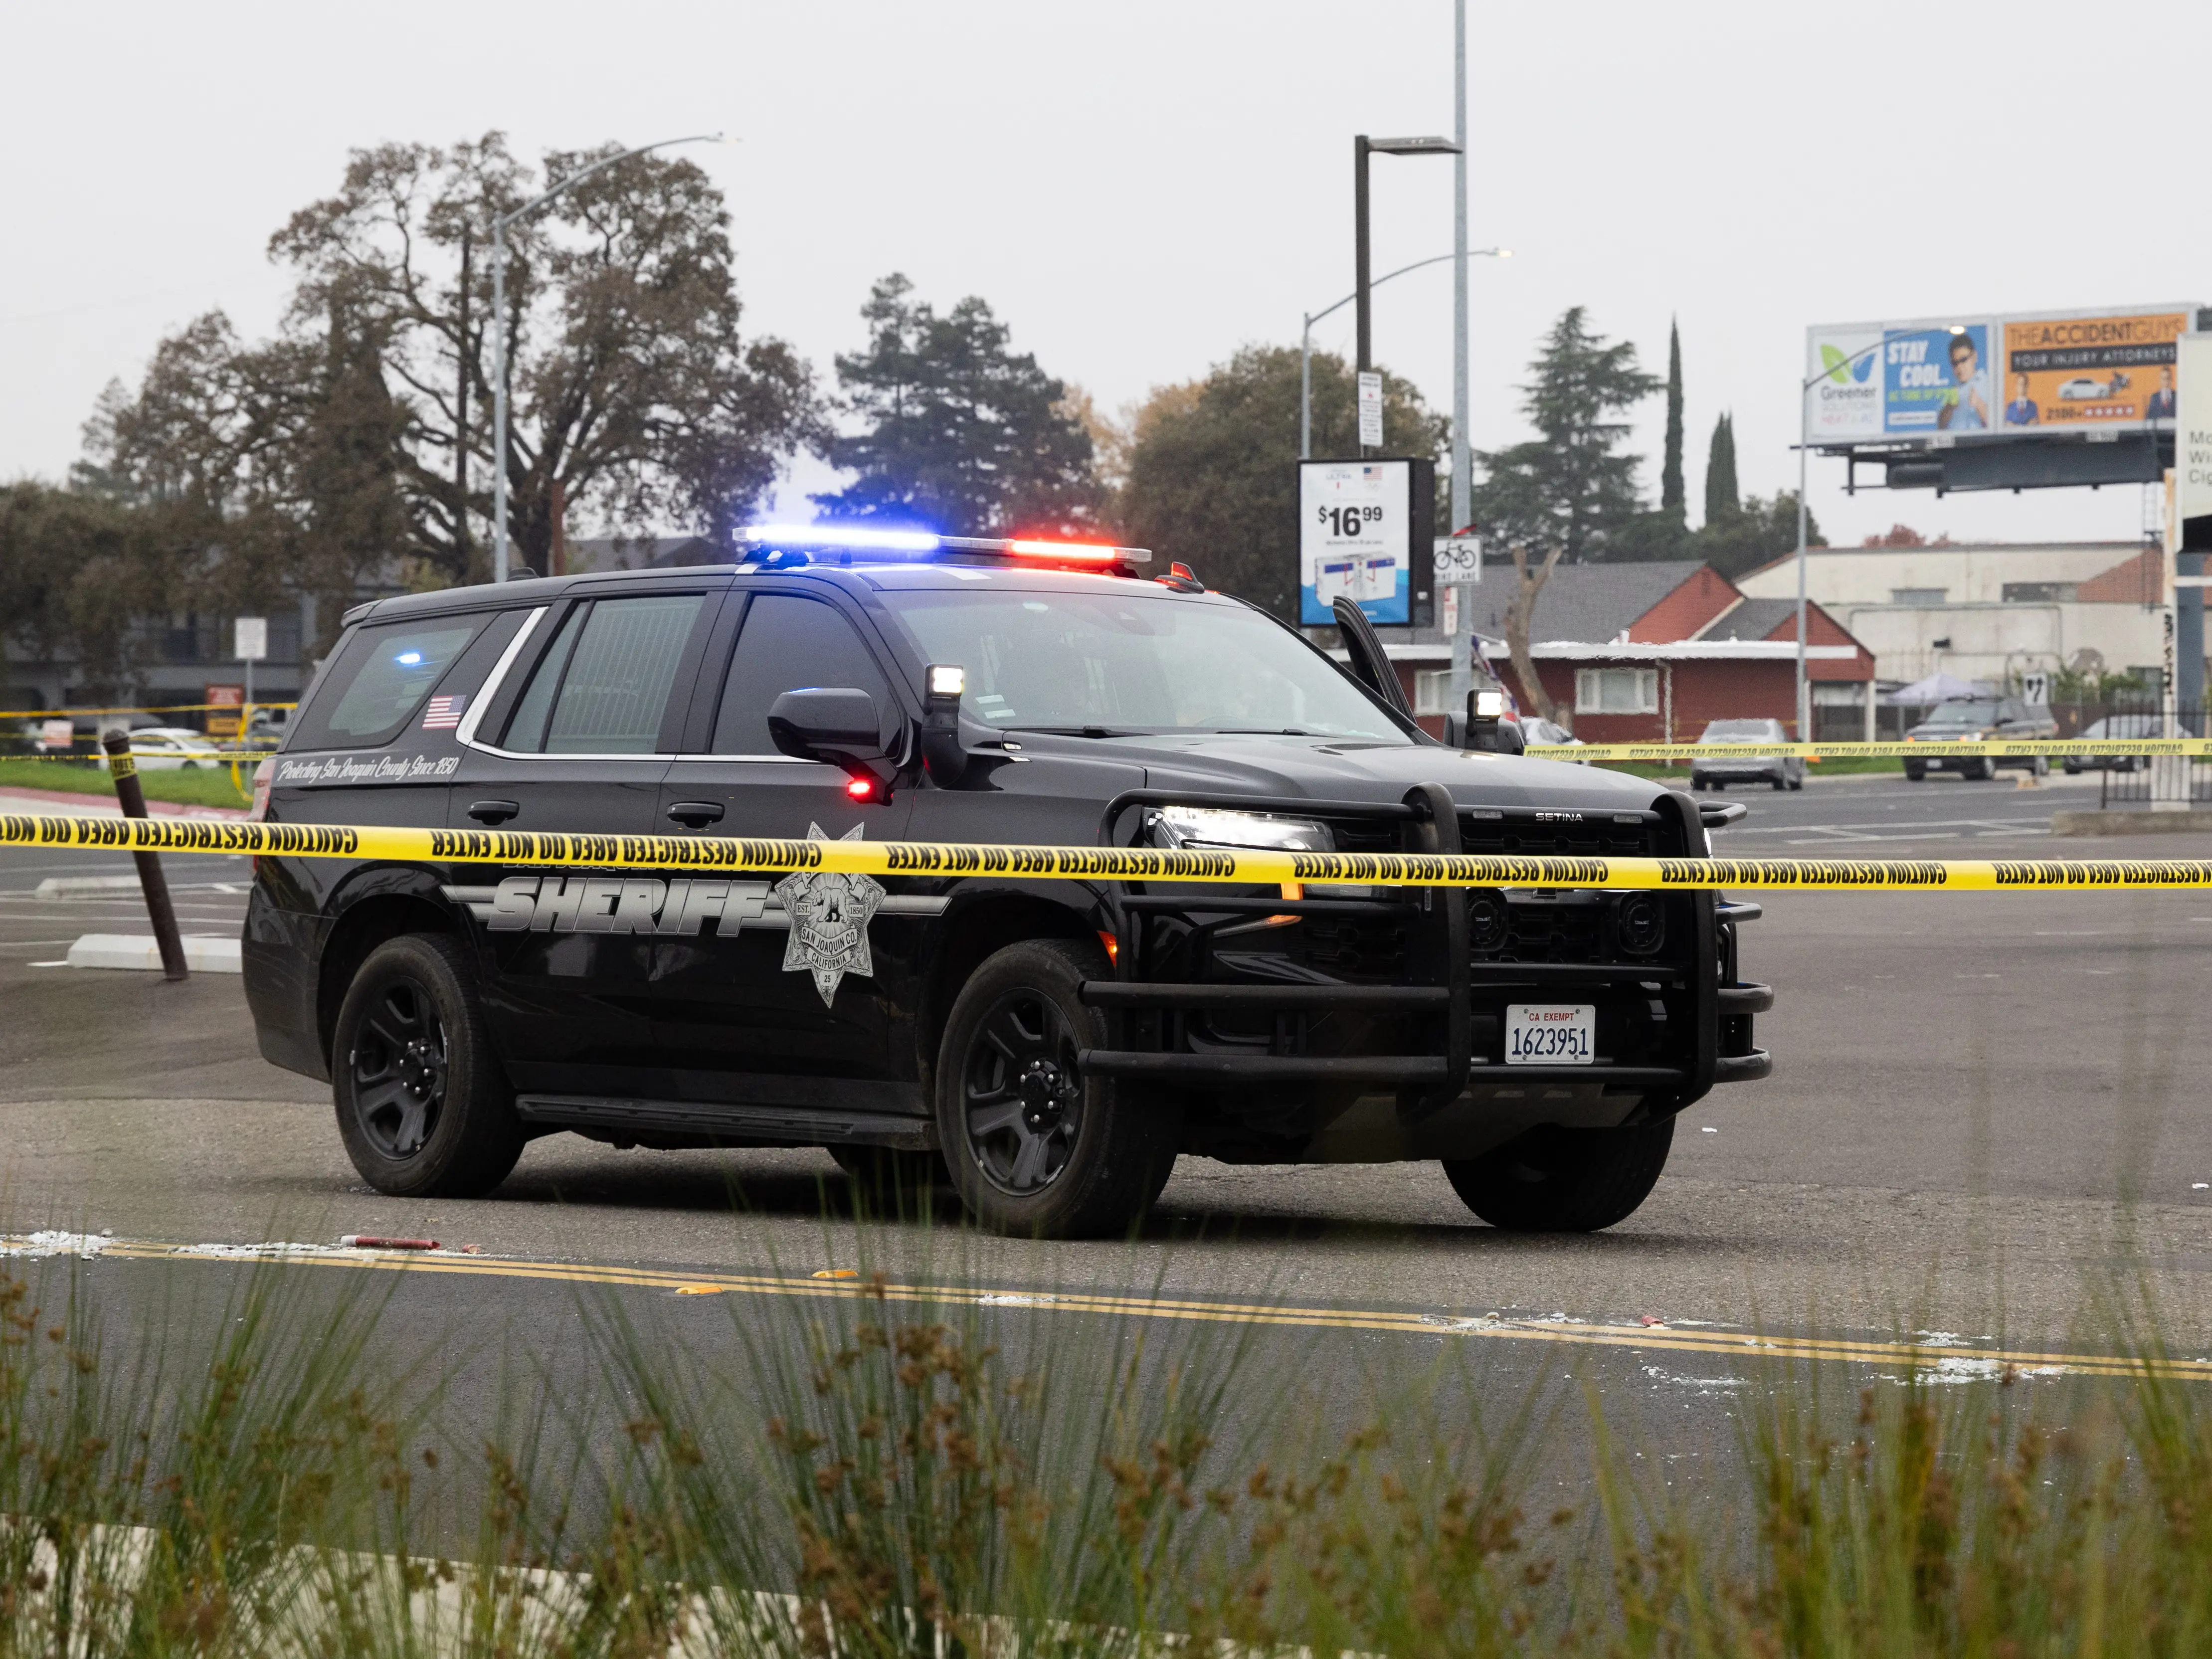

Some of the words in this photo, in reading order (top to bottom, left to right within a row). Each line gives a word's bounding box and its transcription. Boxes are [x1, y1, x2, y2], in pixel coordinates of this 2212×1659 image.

[1887, 340, 1929, 365] STAY
[2015, 353, 2048, 368] YOUR
[2051, 351, 2097, 366] INJURY
[2102, 346, 2175, 362] ATTORNEYS
[1900, 364, 1949, 387] COOL.
[1821, 385, 1877, 400] Greener
[2189, 450, 2212, 464] Wi
[277, 760, 322, 783] Protecting
[320, 758, 341, 779] San
[338, 757, 377, 782] Joaquin
[374, 756, 410, 781] County
[408, 755, 436, 776] Since
[434, 757, 459, 774] 1850
[1536, 812, 1583, 822] SETINA
[39, 817, 71, 843] DO
[72, 818, 130, 845] AREA
[135, 821, 263, 849] RESTRICTED
[266, 825, 358, 853] CAUTION
[429, 831, 491, 857] ENTER
[496, 832, 534, 859] NOT
[538, 833, 565, 860] DO
[569, 835, 618, 861] AREA
[621, 836, 737, 865] RESTRICTED
[740, 840, 822, 867] CAUTION
[884, 845, 941, 870] ENTER
[943, 846, 980, 871] NOT
[982, 847, 1008, 872] DO
[1011, 848, 1055, 873] AREA
[1057, 849, 1160, 875] RESTRICTED
[1162, 852, 1236, 877] CAUTION
[1290, 854, 1342, 878] ENTER
[1344, 855, 1376, 879] NOT
[1377, 856, 1402, 879] DO
[1402, 856, 1444, 880] AREA
[1446, 857, 1540, 881] RESTRICTED
[1540, 858, 1608, 882] CAUTION
[1656, 860, 1704, 883] ENTER
[1707, 860, 1736, 883] NOT
[1736, 861, 1759, 883] DO
[1758, 861, 1797, 884] AREA
[1799, 861, 1884, 884] RESTRICTED
[1884, 862, 1947, 885] CAUTION
[1991, 862, 2035, 884] ENTER
[2037, 862, 2064, 884] NOT
[2064, 862, 2085, 884] DO
[2084, 862, 2120, 884] AREA
[2119, 862, 2200, 884] RESTRICTED
[486, 876, 772, 937] SHERIFF
[797, 905, 809, 914] EST.
[850, 906, 863, 915] 1850
[801, 930, 816, 945] SAN
[816, 937, 845, 955] JOAQUIN
[846, 931, 857, 944] CO.
[811, 953, 847, 969] CALIFORNIA
[824, 974, 831, 983] 25
[1529, 1013, 1540, 1021] CA
[1544, 1013, 1574, 1021] EXEMPT
[1511, 1027, 1589, 1056] 1623951
